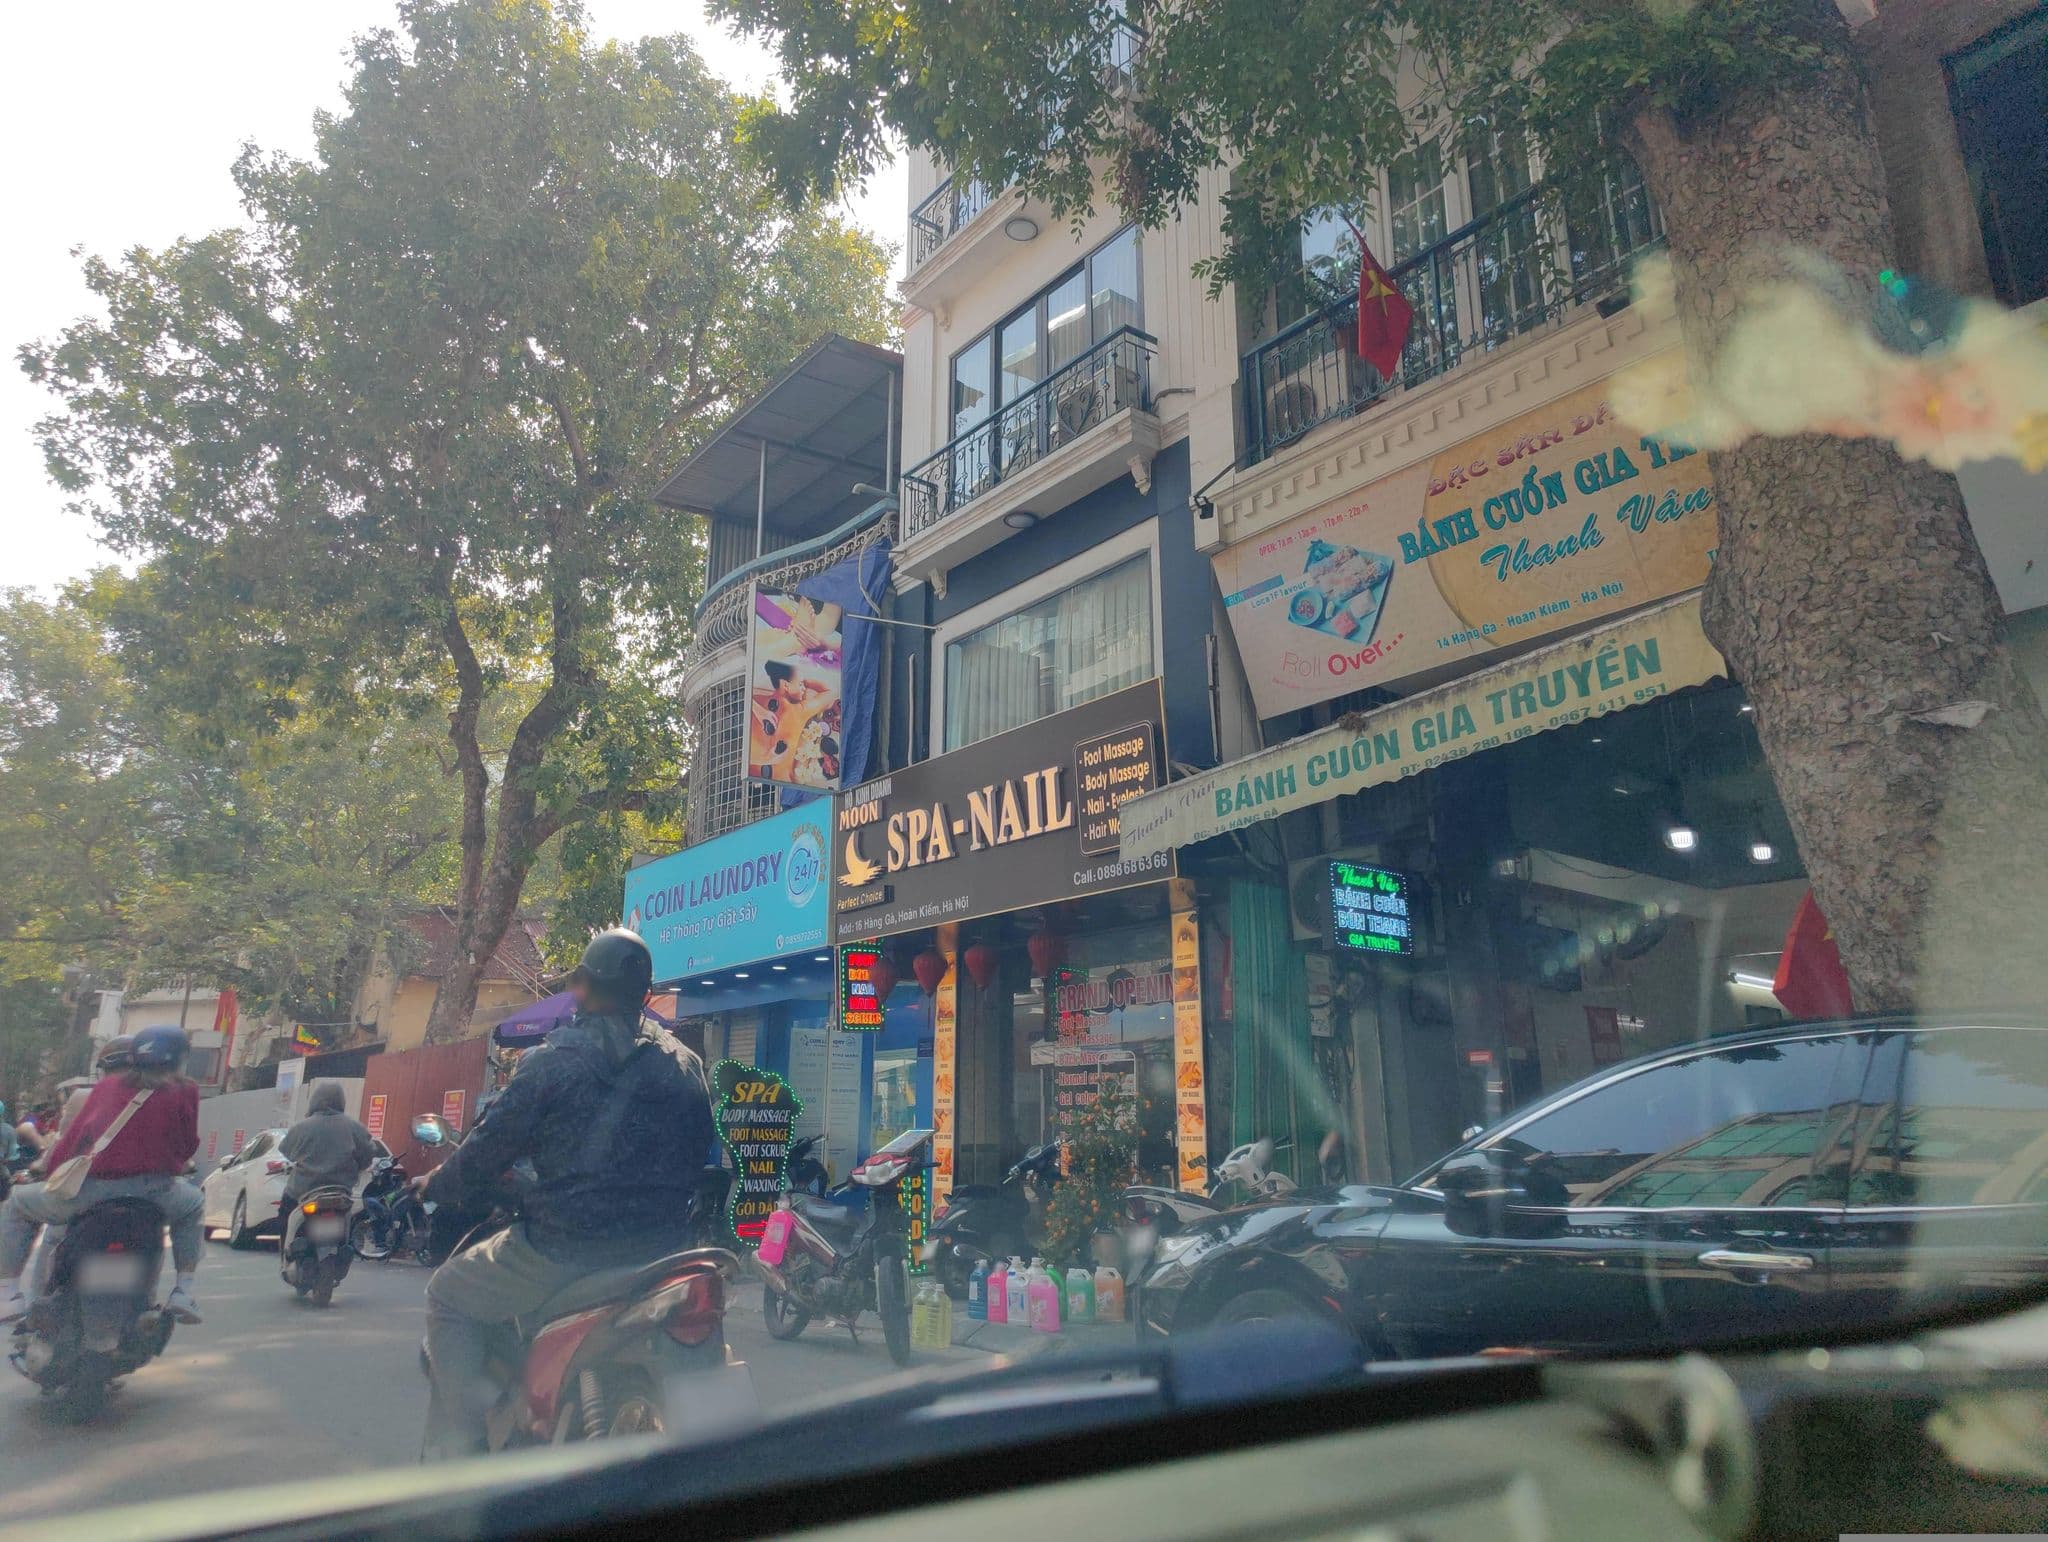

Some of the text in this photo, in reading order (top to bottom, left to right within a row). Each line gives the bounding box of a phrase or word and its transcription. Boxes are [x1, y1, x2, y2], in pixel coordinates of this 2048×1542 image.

[1398, 507, 1479, 565] BÁNH
[1483, 465, 1568, 531] CUỐN
[1574, 446, 1639, 495] GIA
[1480, 487, 1713, 582] Thanh Vân
[1436, 637, 1450, 650] 14
[1283, 651, 1320, 678] Roll
[1215, 764, 1297, 818] BÁNH
[1411, 702, 1477, 752] GIA
[1486, 637, 1662, 725] TRUYỀN
[1083, 737, 1144, 766] Foot Massage
[1086, 761, 1150, 791] Body Massage
[839, 800, 878, 831] MOON
[1087, 796, 1105, 815] Nail
[1088, 822, 1107, 840] Hair
[794, 859, 819, 881] 24/7
[645, 883, 686, 922] COIN
[689, 850, 784, 907] LAUNDRY
[837, 890, 883, 911] Perfect Choice
[1057, 981, 1109, 1012] GRAND
[731, 1081, 782, 1104] SPA
[721, 1109, 791, 1123] BODY MASSAGE
[730, 1128, 788, 1141] FOOT MASSAGE
[740, 1144, 786, 1157] FOOT SCRUB
[749, 1161, 776, 1174] NAIL
[744, 1178, 780, 1192] WAXING
